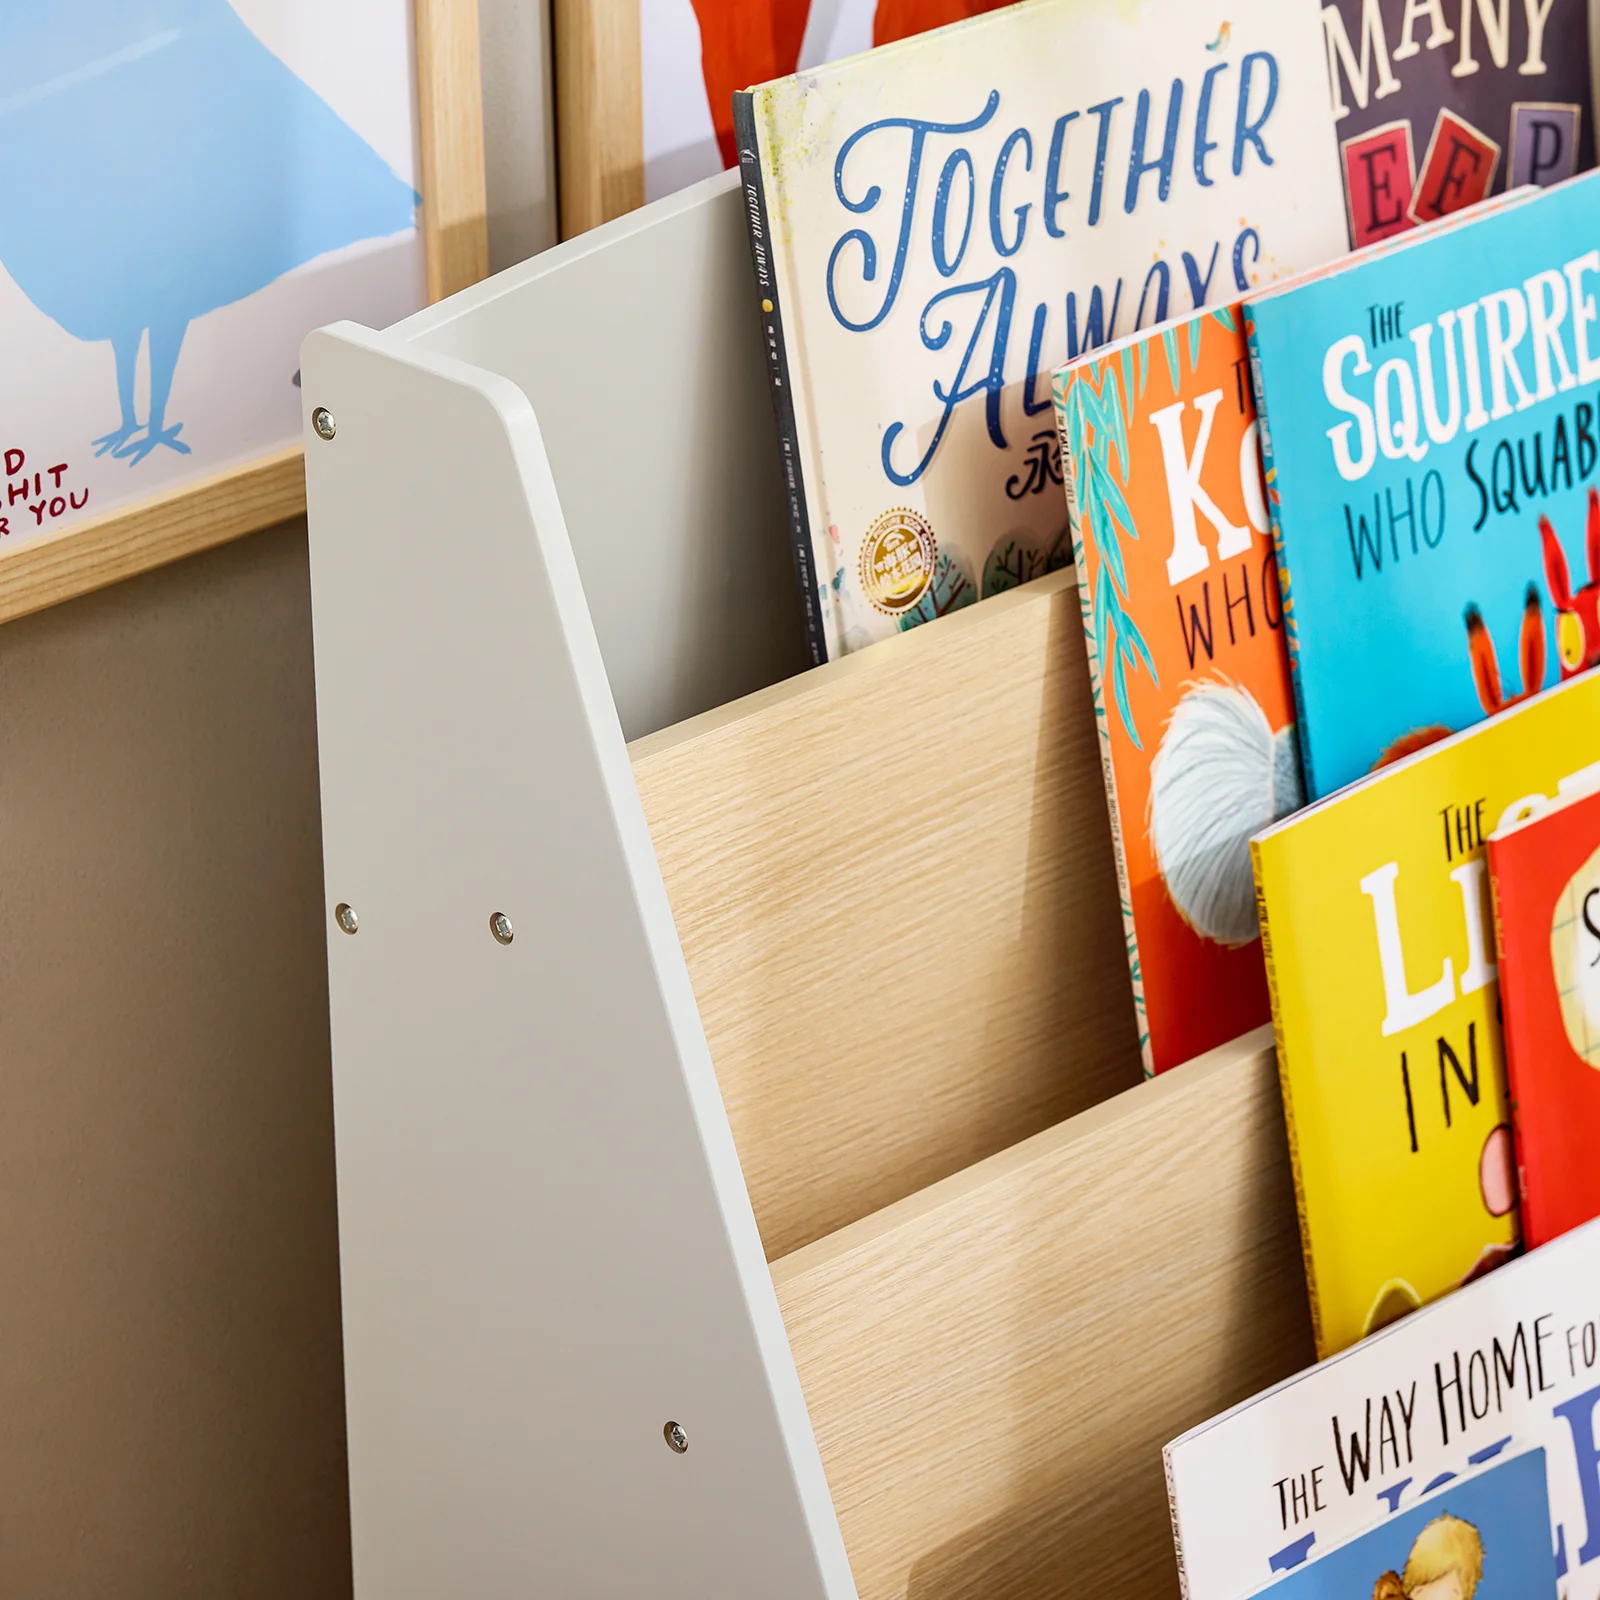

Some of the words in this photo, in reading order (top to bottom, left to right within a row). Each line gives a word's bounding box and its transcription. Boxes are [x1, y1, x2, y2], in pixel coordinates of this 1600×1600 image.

[746, 184, 763, 238] TOGETHER
[755, 242, 770, 287] ALWAYS
[826, 51, 1280, 333] TOGETHER
[881, 227, 1261, 487] ALWAYS
[1322, 249, 1600, 482] SQUIRRE
[1368, 301, 1406, 348] THE
[4, 448, 25, 476] D
[29, 487, 88, 525] YOU
[1343, 470, 1446, 580] WHO
[1176, 550, 1283, 670] WHO
[1438, 797, 1487, 862] THE
[1272, 1465, 1327, 1531] THE
[1331, 1381, 1417, 1496] WAY
[1434, 1313, 1555, 1446] HOME
